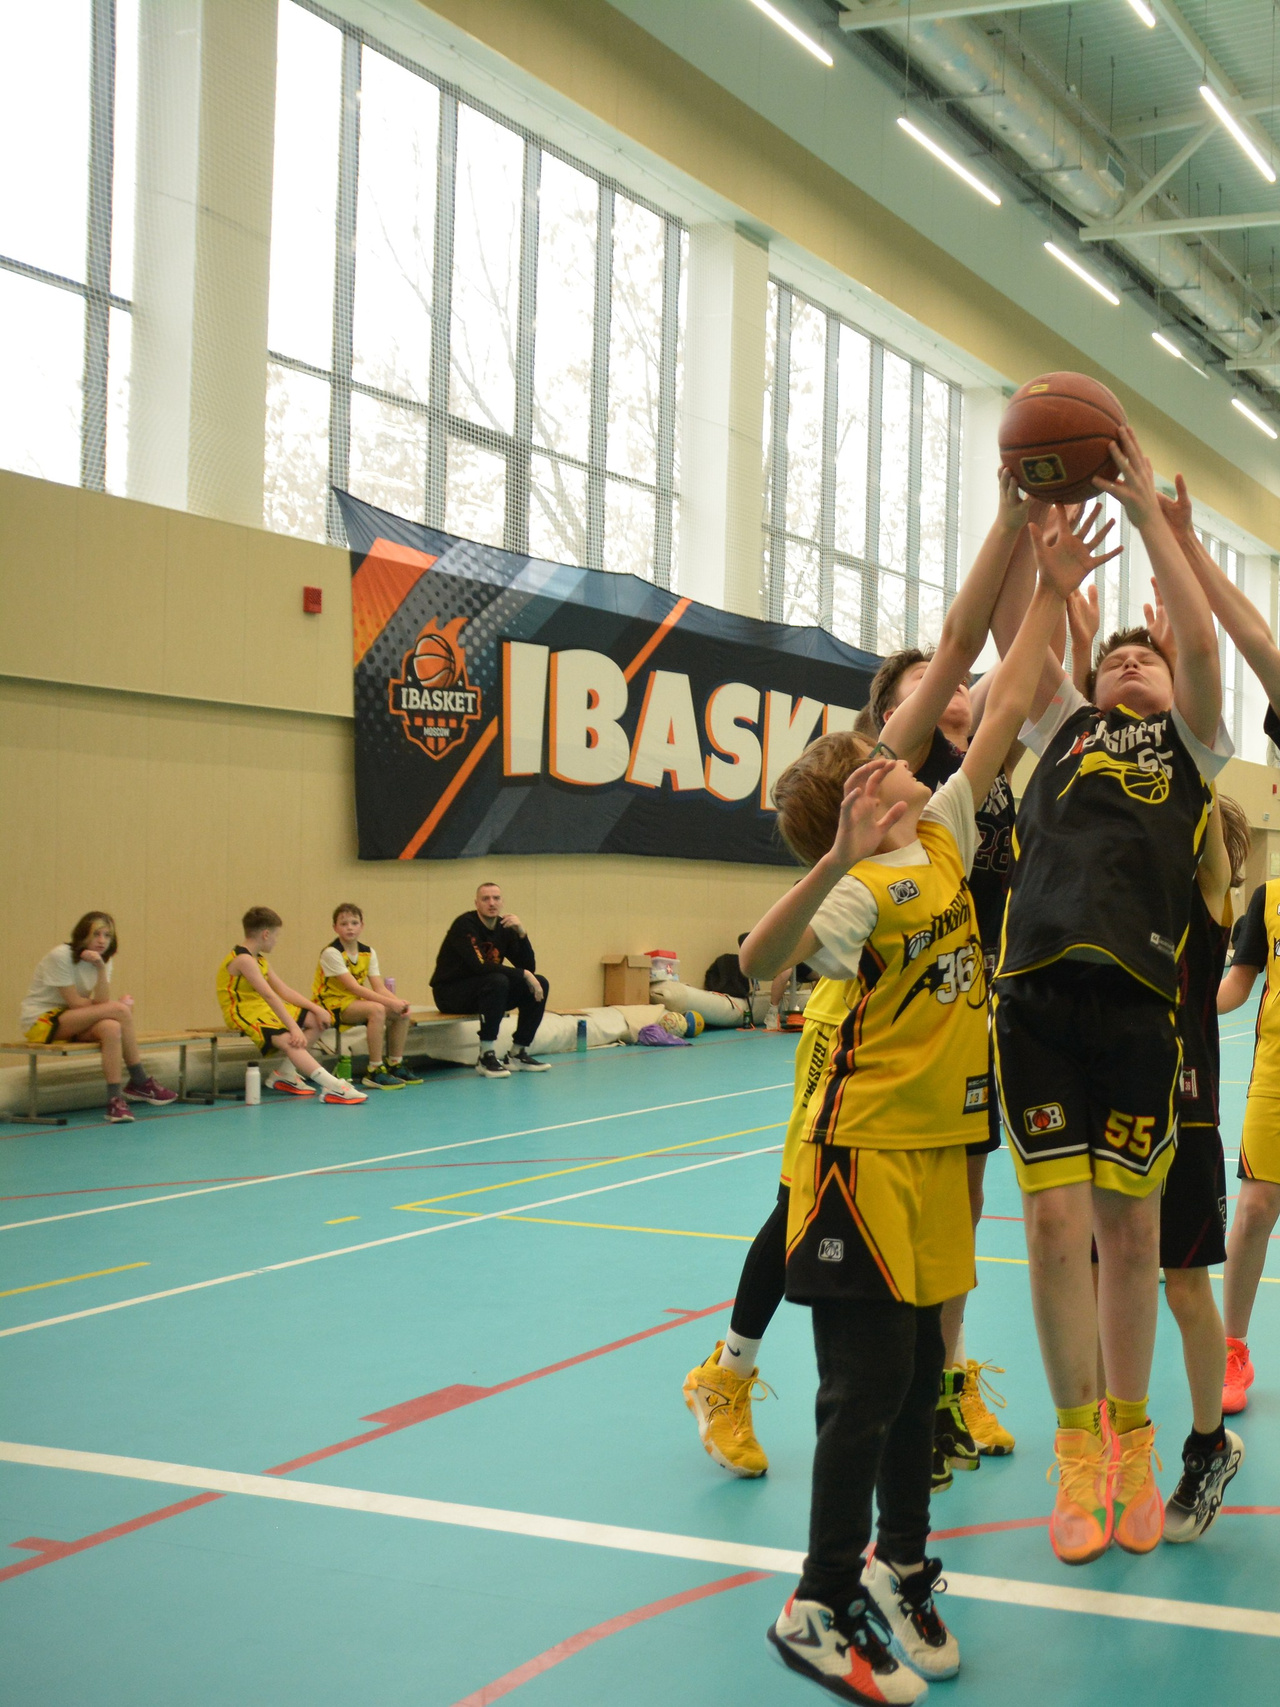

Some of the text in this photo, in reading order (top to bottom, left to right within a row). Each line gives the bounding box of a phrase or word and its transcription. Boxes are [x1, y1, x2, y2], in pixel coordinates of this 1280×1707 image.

[401, 687, 477, 713] IBASKET
[423, 726, 450, 737] MOSCOW
[936, 942, 976, 1005] 36
[1104, 1108, 1156, 1158] 55
